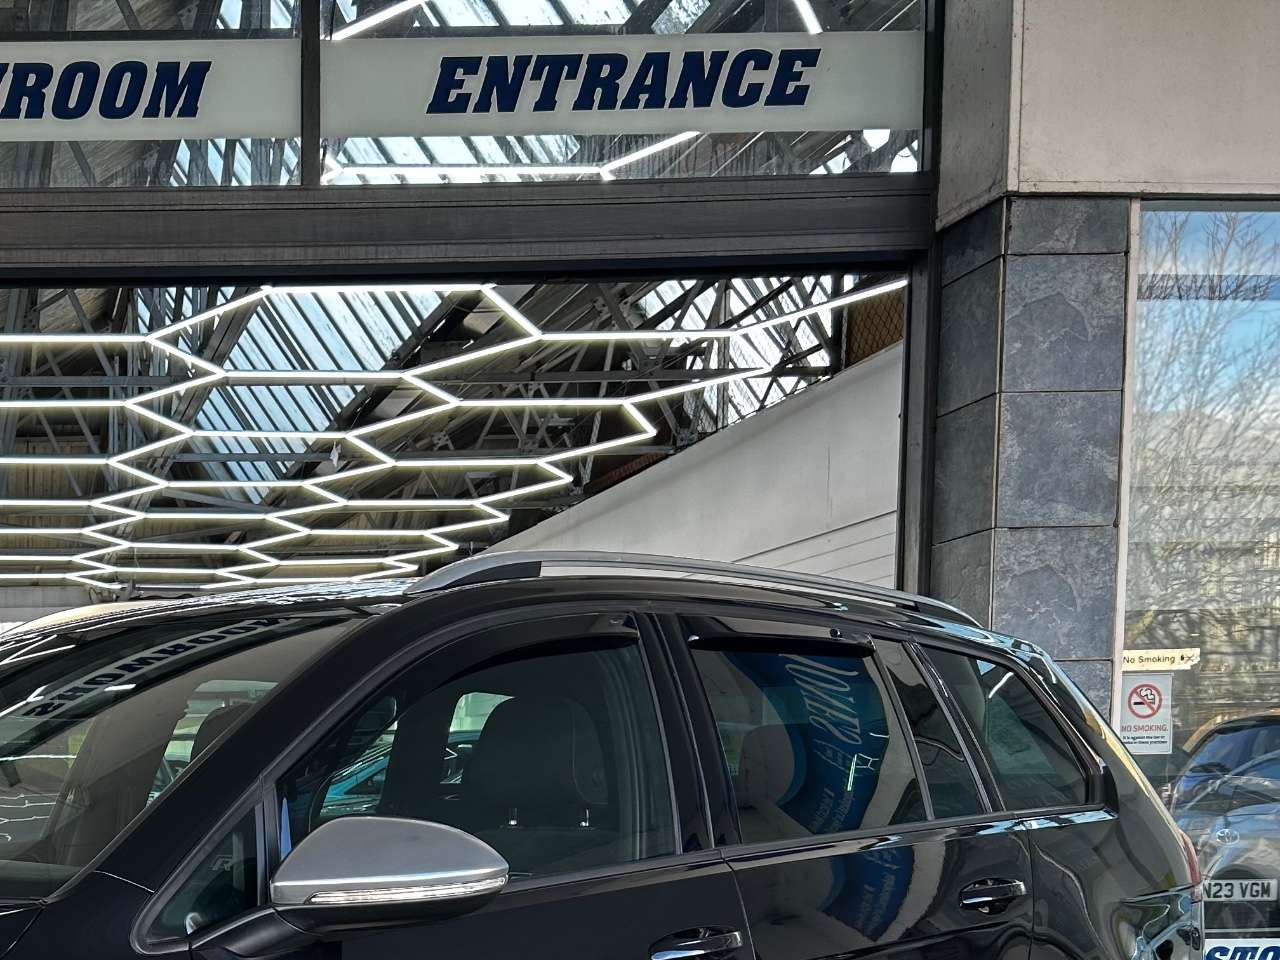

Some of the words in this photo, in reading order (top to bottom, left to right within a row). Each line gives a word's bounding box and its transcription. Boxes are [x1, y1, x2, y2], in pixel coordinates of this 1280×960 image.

[425, 48, 822, 114] ENTRANCE
[1138, 655, 1176, 665] Smoking
[1240, 882, 1271, 898] VGM
